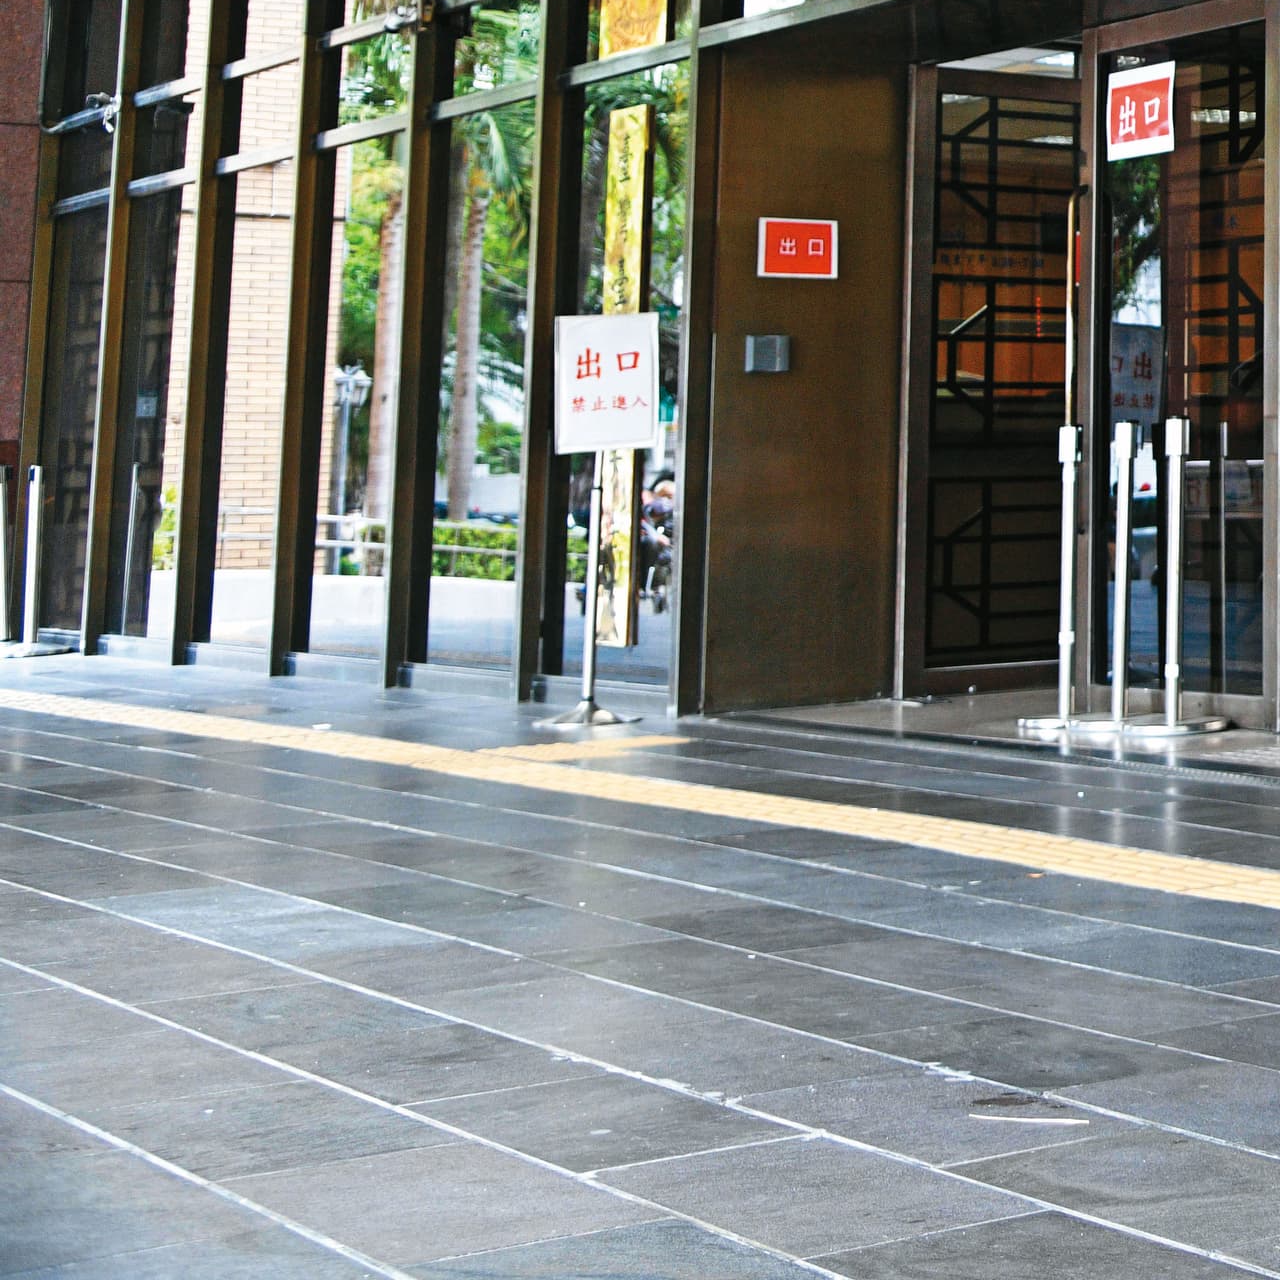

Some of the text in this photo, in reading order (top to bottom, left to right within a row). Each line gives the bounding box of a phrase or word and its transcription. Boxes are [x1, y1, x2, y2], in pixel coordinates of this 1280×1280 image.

[1119, 95, 1160, 136] 出口
[779, 237, 824, 256] 出口
[576, 347, 640, 380] 出口
[572, 395, 648, 413] 禁止進入
